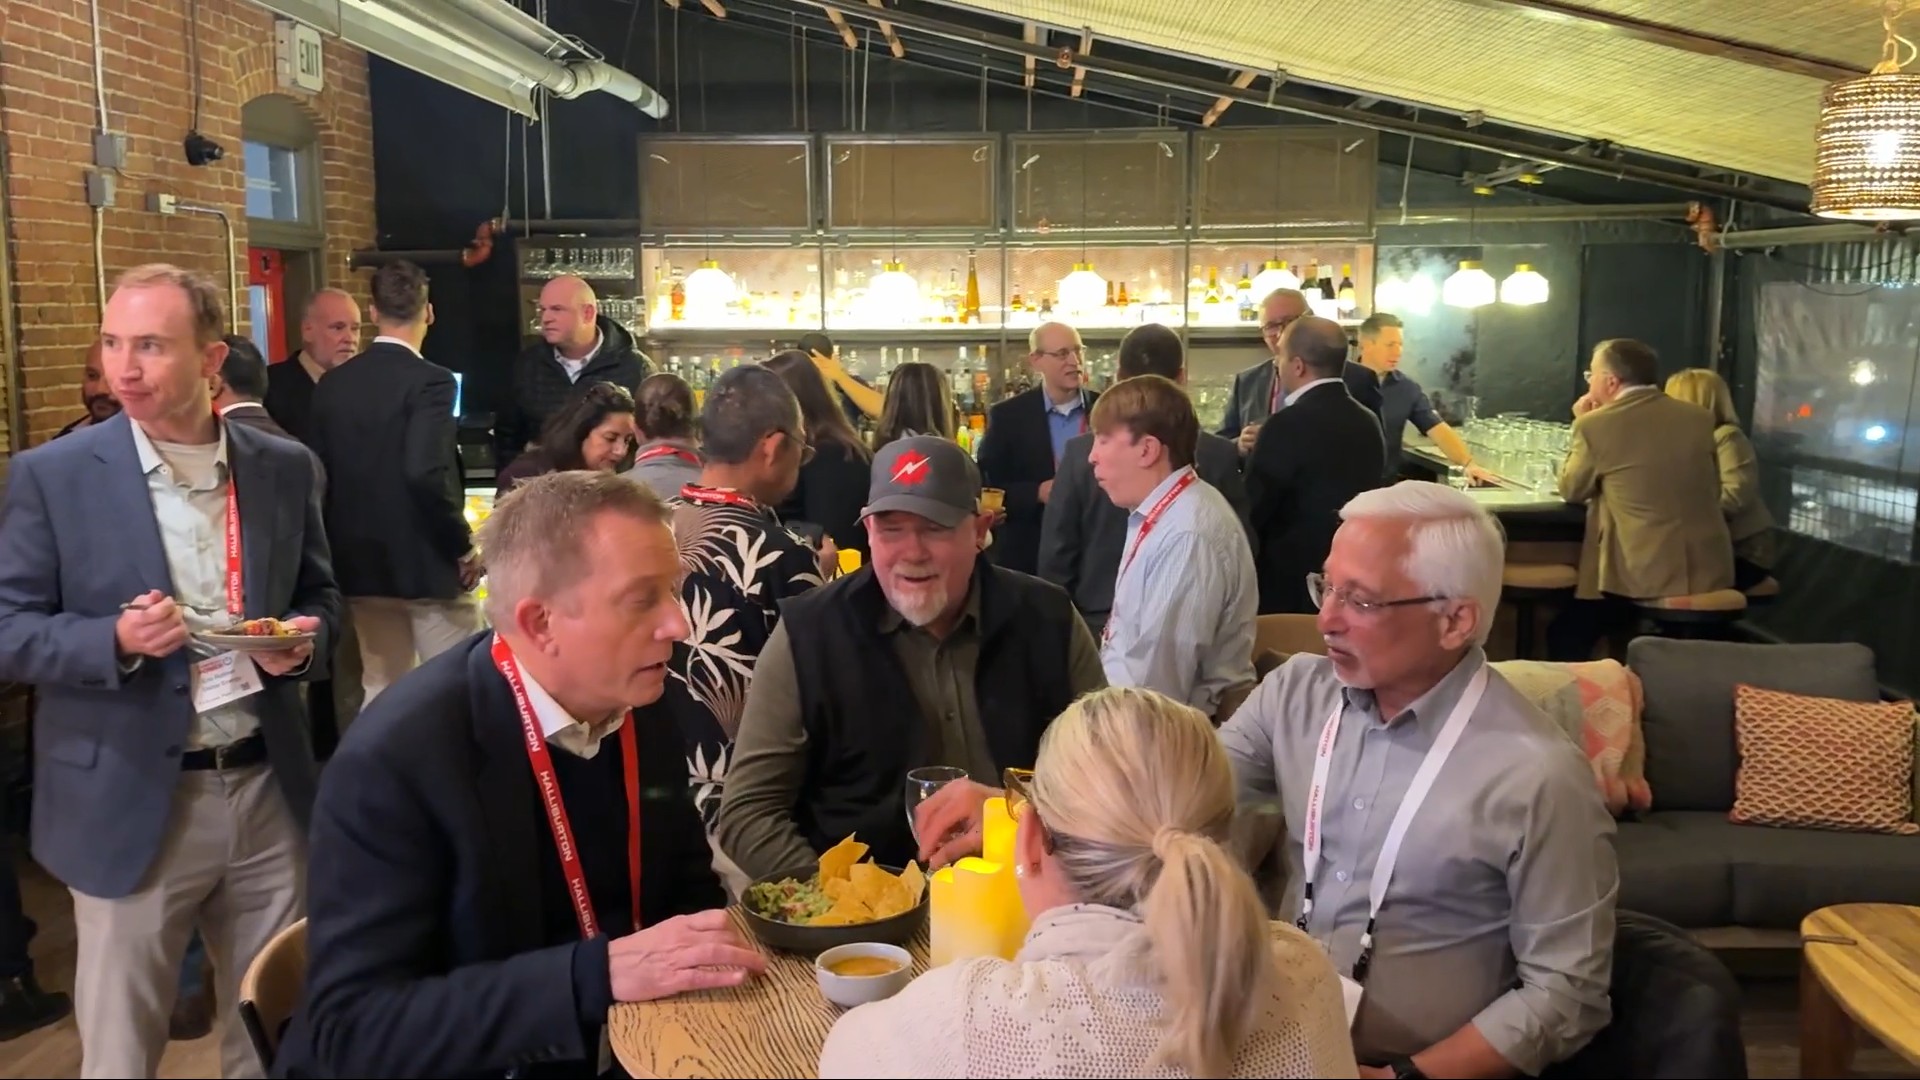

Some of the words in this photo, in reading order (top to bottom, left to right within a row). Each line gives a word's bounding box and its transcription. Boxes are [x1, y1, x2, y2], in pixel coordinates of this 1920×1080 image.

[299, 38, 319, 78] EXIT
[229, 495, 238, 558] HALLIBURTON
[500, 660, 541, 753] HALLIBURTON
[540, 770, 573, 863] HALLIBURTON
[1308, 785, 1320, 851] HALLIBURTON
